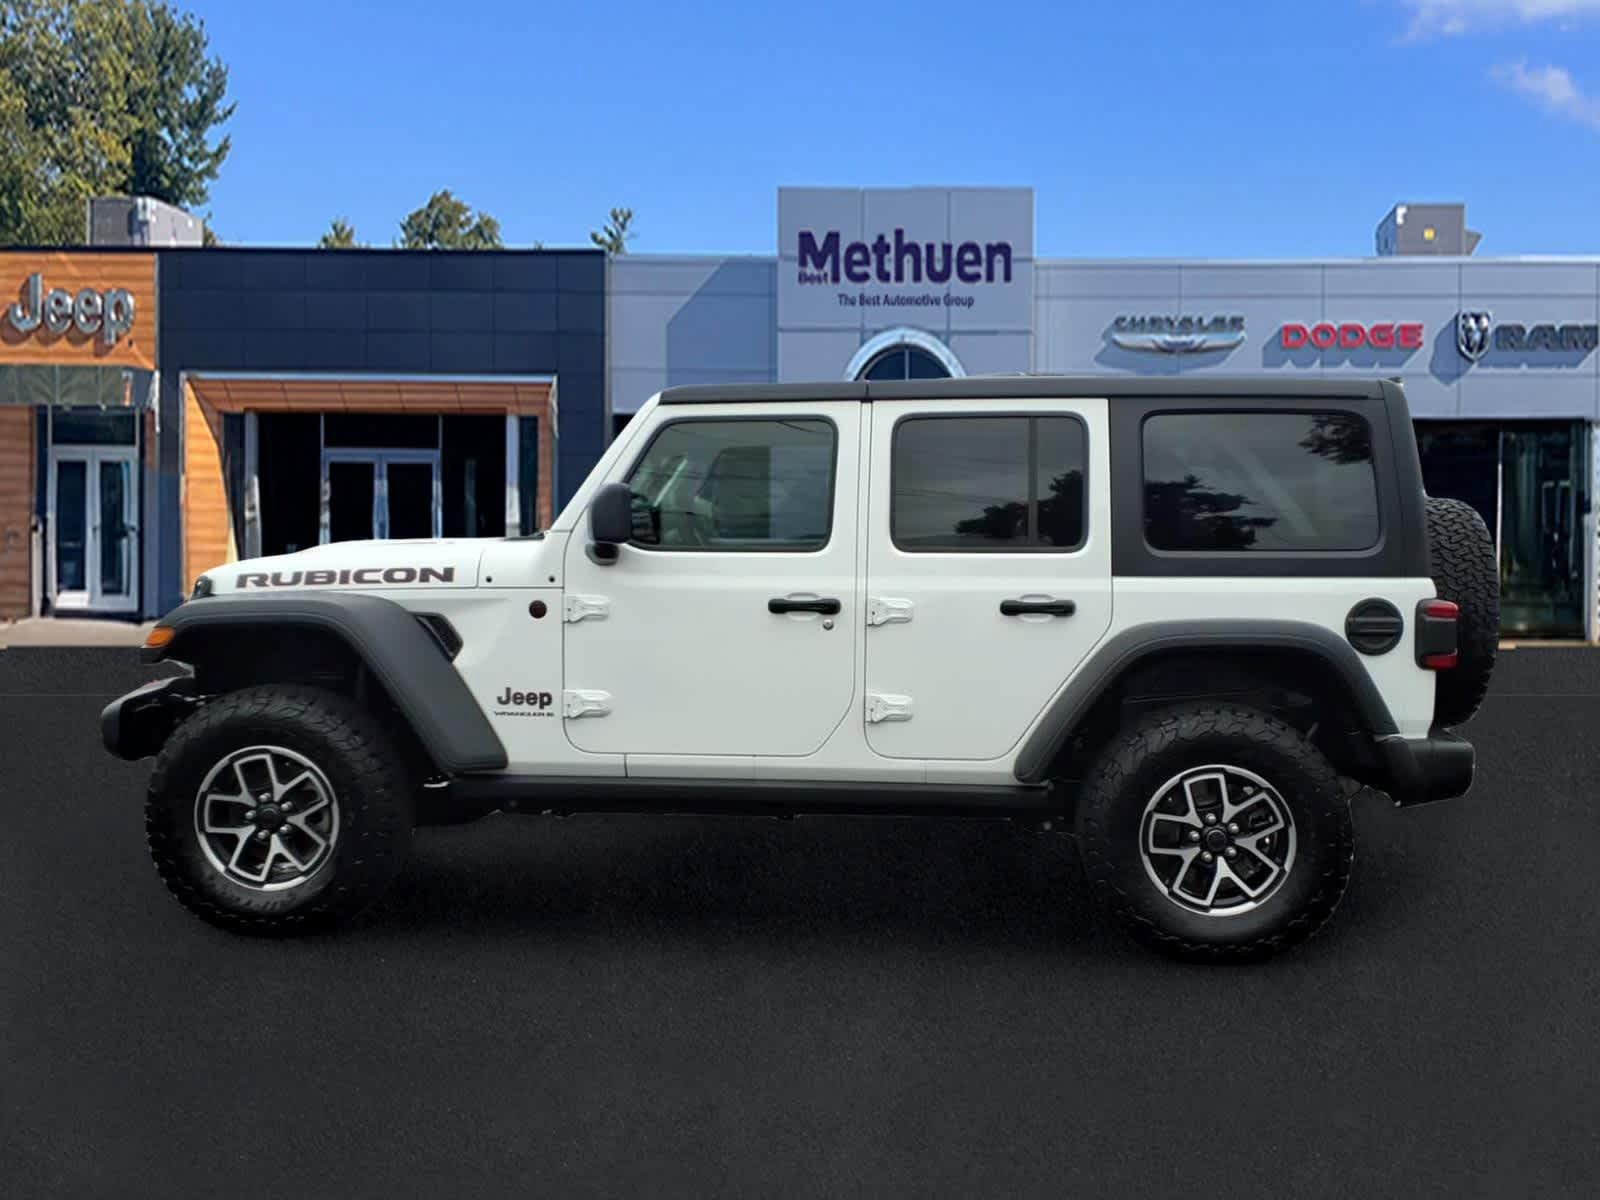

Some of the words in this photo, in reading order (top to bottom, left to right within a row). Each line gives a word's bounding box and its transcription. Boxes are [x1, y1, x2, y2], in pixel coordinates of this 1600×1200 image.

[797, 228, 1013, 284] Methuen
[9, 273, 135, 346] Jeep
[838, 293, 857, 307] The
[859, 293, 881, 307] Best
[883, 293, 942, 307] Automotive
[943, 293, 975, 309] Group
[1281, 322, 1425, 350] DODGE
[1494, 323, 1599, 352] RAM
[235, 566, 455, 589] RUBICON
[496, 686, 553, 710] Jeep
